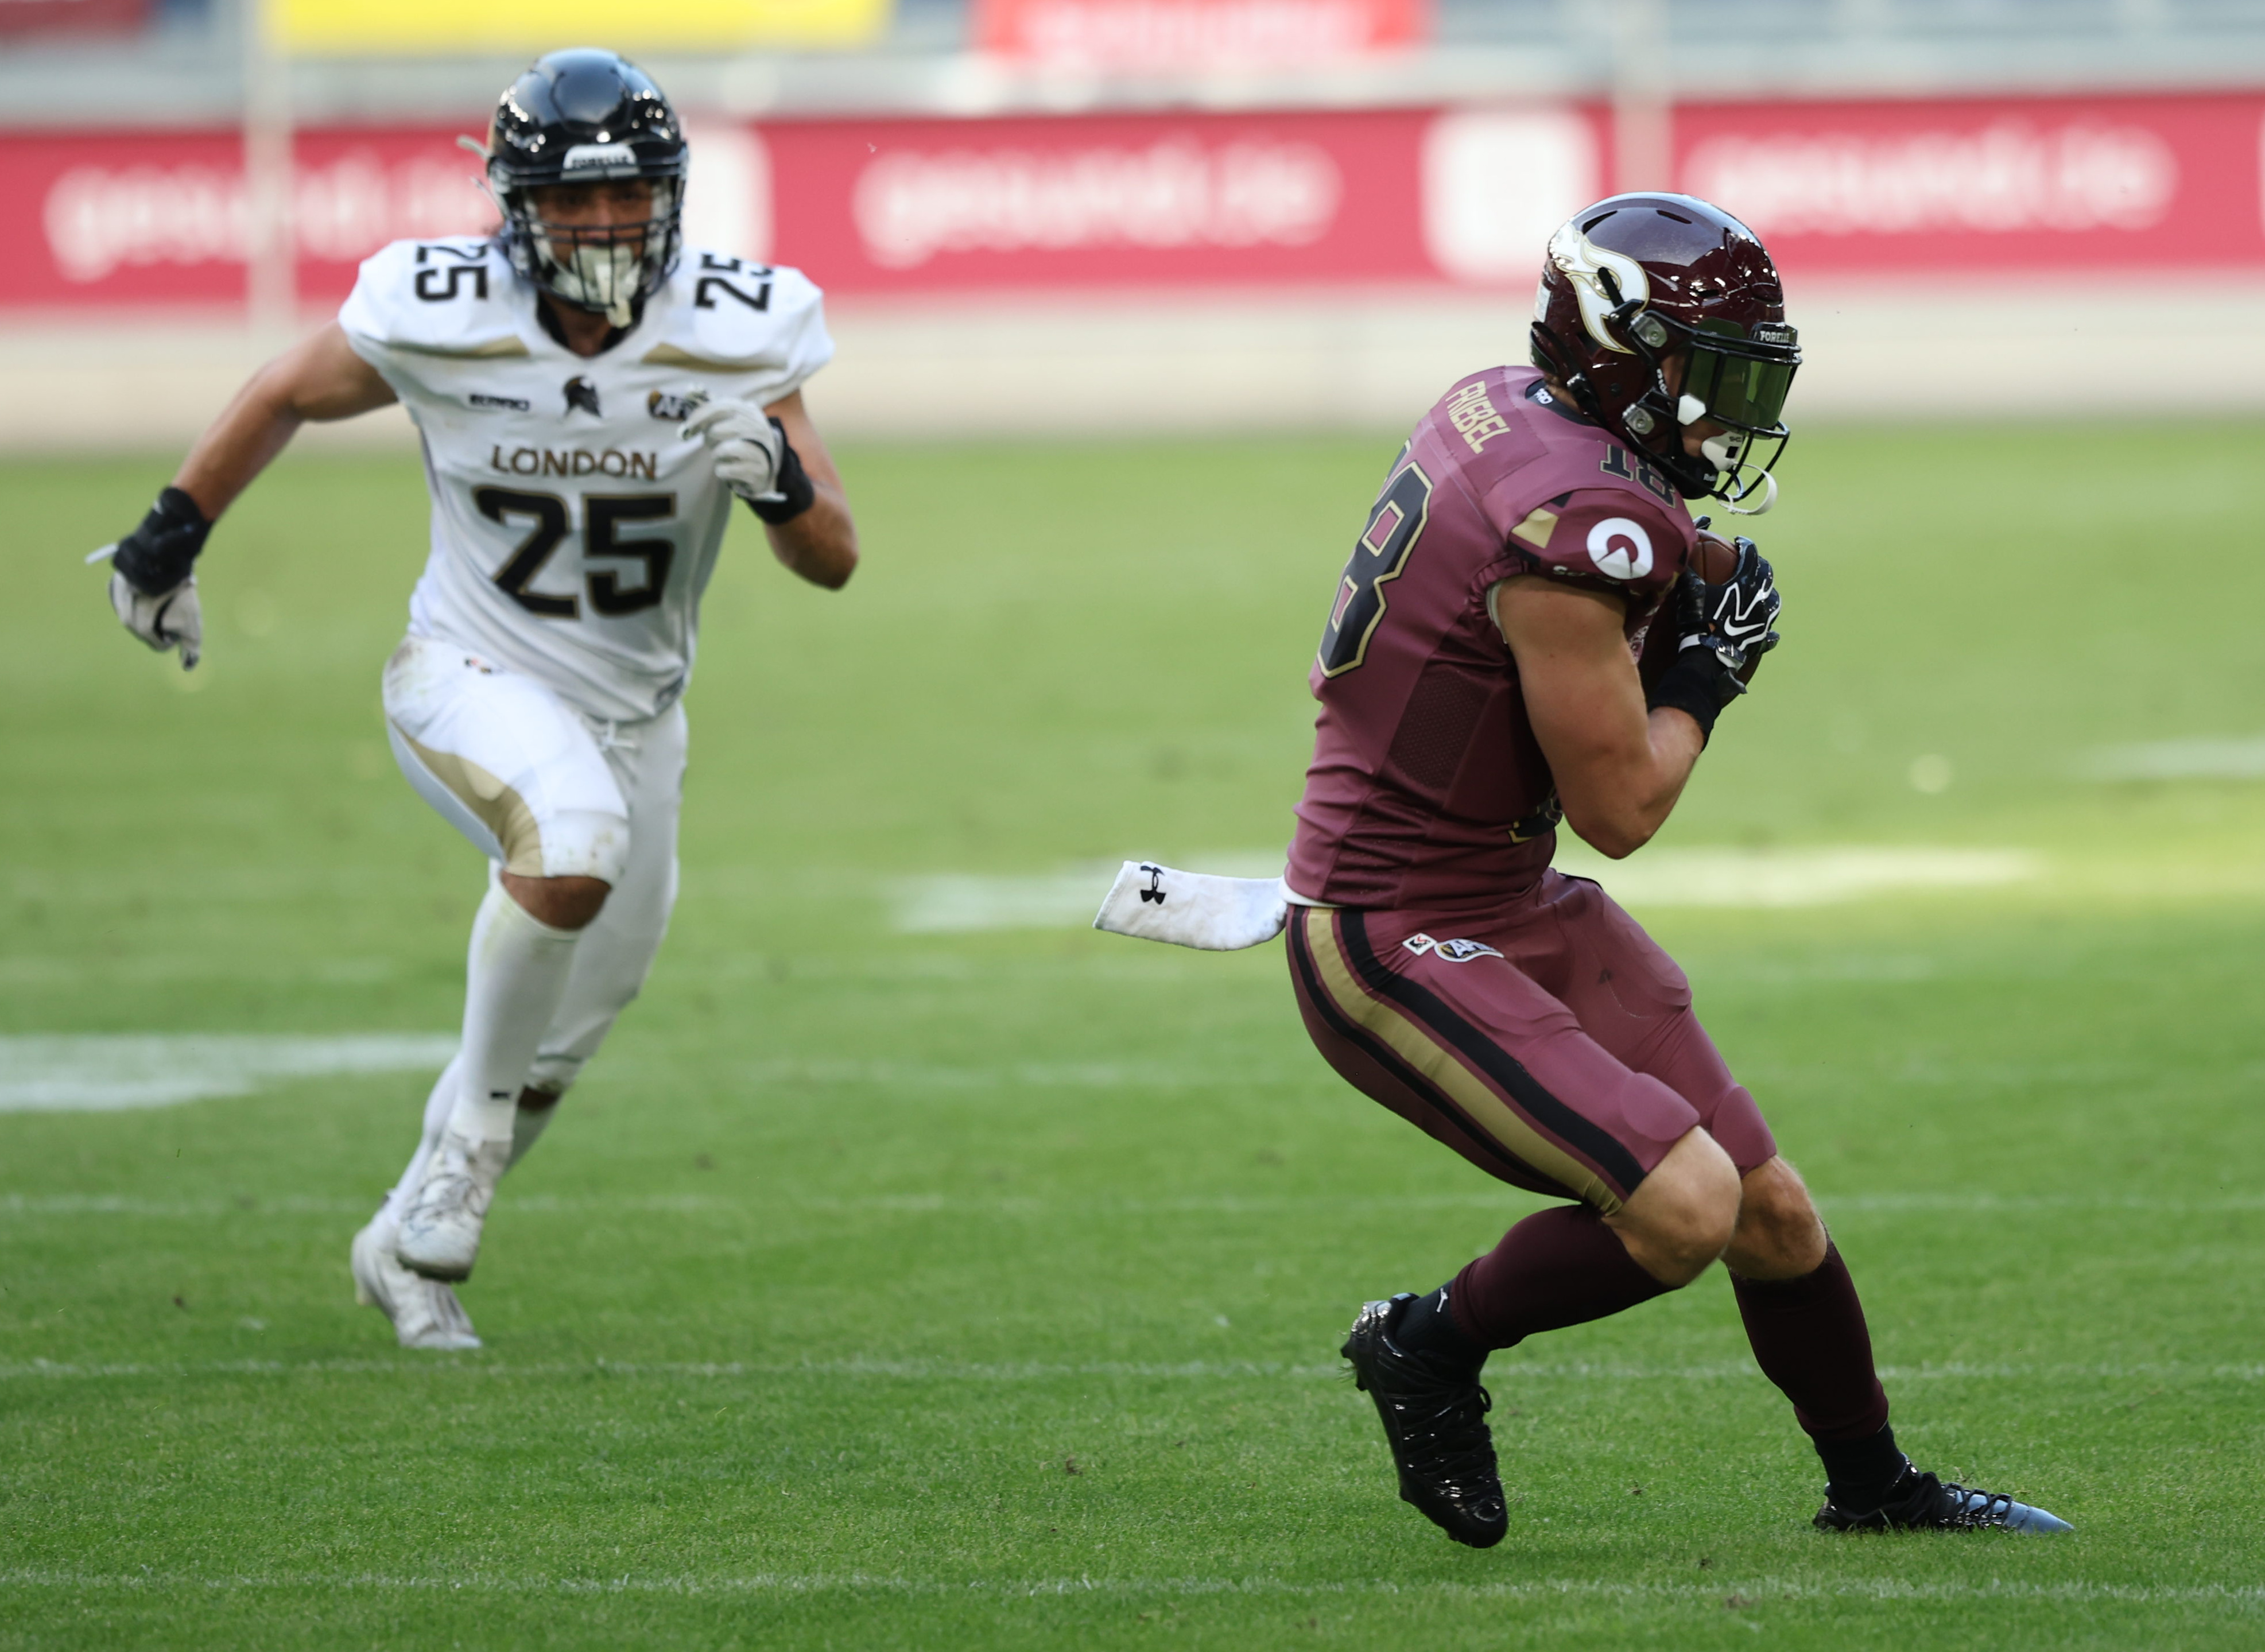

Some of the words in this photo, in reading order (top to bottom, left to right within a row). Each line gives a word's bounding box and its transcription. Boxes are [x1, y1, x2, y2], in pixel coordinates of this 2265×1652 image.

[1445, 380, 1512, 455] FRIEBEL
[491, 444, 657, 481] LONDON
[471, 484, 677, 619] 25
